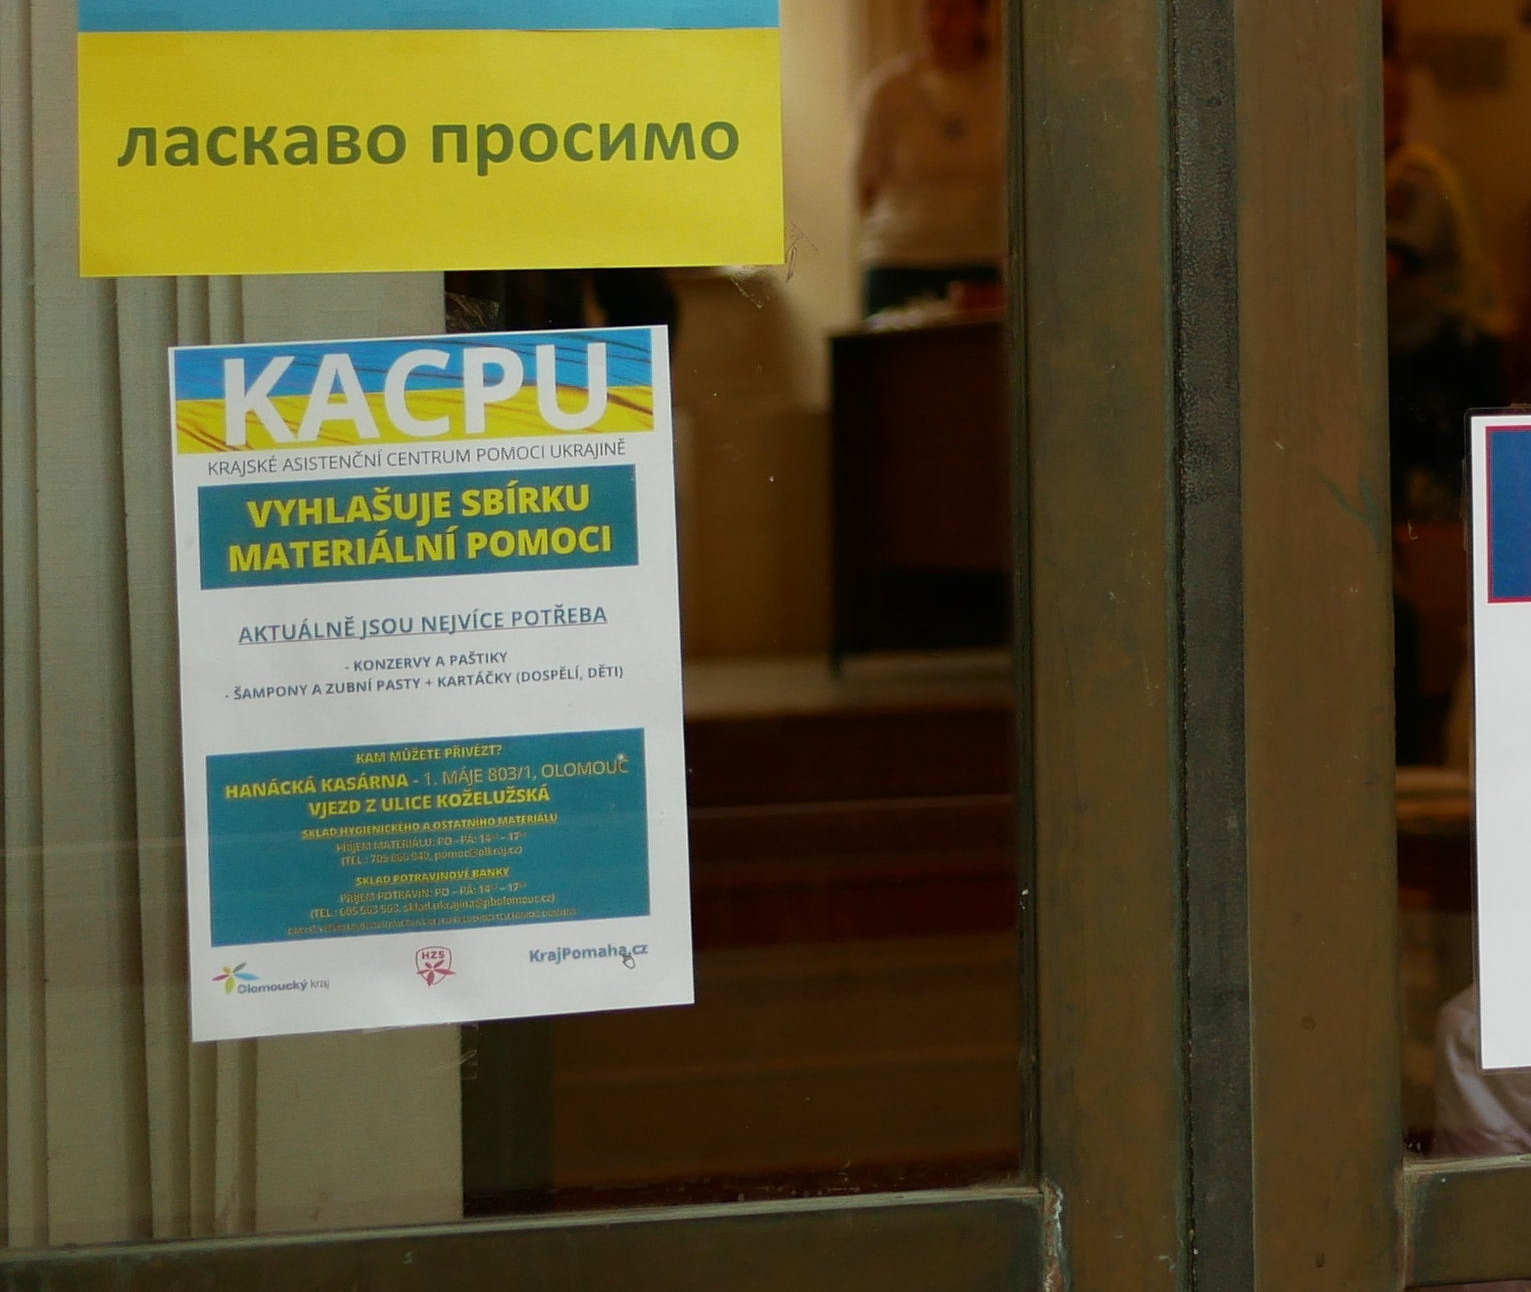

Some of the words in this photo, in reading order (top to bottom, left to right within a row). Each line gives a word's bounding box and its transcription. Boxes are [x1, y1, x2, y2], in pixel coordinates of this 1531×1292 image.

[117, 122, 407, 168] ласкаво
[431, 119, 739, 177] просимо
[223, 342, 609, 448] KACPU
[207, 455, 277, 477] KRAJSKÉ
[282, 449, 383, 472] ASISTENČNÍ
[386, 448, 471, 467] CENTRUM
[476, 445, 545, 462] POMOCI
[550, 439, 626, 460] UKRAJINĚ
[246, 485, 452, 529] VYHLAŠUJE
[462, 480, 590, 518] SBÍRKU
[229, 525, 460, 573] MATERIÁLNÍ
[467, 525, 612, 559] POMOCI
[239, 616, 355, 644] AKTUÁLNĚ
[360, 617, 413, 640] JSOU
[421, 609, 504, 635] NEJVÍCE
[511, 604, 608, 627] POTŘEBA
[353, 656, 431, 672] KONZERVY
[435, 656, 445, 667] A
[450, 651, 508, 666] PAŠTIKY
[233, 684, 308, 701] ŠAMPONY
[311, 683, 322, 695] A
[325, 678, 373, 694] ZUBNÍ
[376, 677, 421, 692] PASTY
[437, 670, 512, 688] KARTÁČKY
[516, 665, 583, 685] (DOSPĚLÍ,
[587, 664, 624, 679] DĚTI)
[356, 751, 386, 764] KAM
[390, 747, 441, 764] MŮŽETE
[444, 744, 503, 758] PŘIVÉZT?
[225, 776, 317, 799] HANÁCKÁ
[321, 772, 409, 793] KASÁRNA
[424, 771, 437, 786] 1.
[442, 766, 483, 786] MÁJE
[488, 766, 537, 782] 803/1,
[541, 758, 629, 778] OLOMOUC
[309, 799, 361, 819] VJEZD
[365, 798, 377, 813] Z
[381, 795, 432, 812] ULICE
[437, 783, 550, 808] KOŽELUŽSKÁ
[302, 828, 337, 839] SKLAD
[340, 820, 420, 836] HYGIENICKÉHO
[433, 816, 496, 830] OSTATNÍHO
[356, 875, 391, 886] SKLAD
[472, 866, 510, 878] BANKY
[420, 949, 446, 960] HZS
[529, 942, 648, 964] KrajPomaha.cz
[237, 978, 308, 995] Olomoucký
[310, 975, 330, 991] kraj
